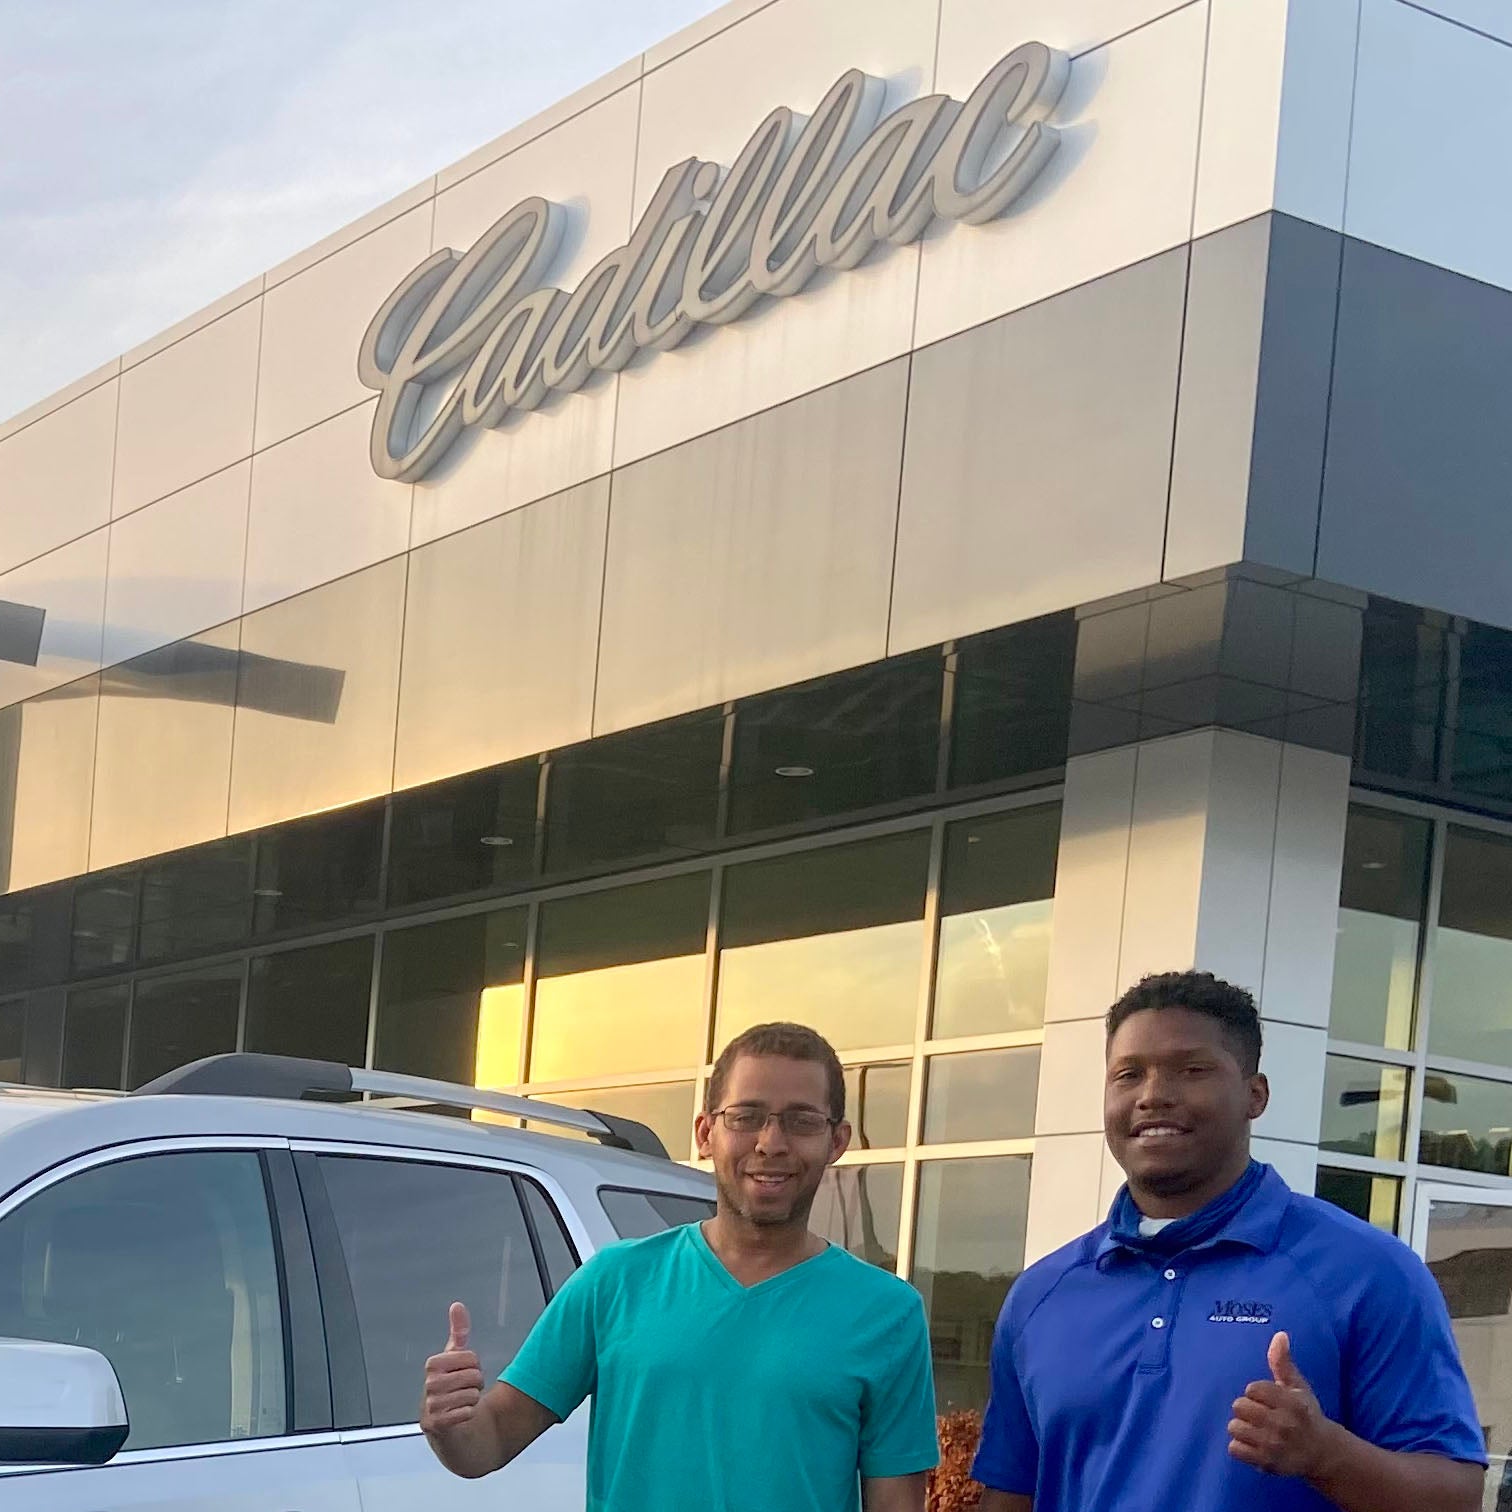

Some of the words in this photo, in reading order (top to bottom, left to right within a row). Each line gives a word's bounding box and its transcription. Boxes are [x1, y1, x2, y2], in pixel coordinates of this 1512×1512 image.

[357, 41, 1072, 483] Cadillac
[1208, 1315, 1234, 1323] AUTO
[1235, 1315, 1269, 1324] GROUP
